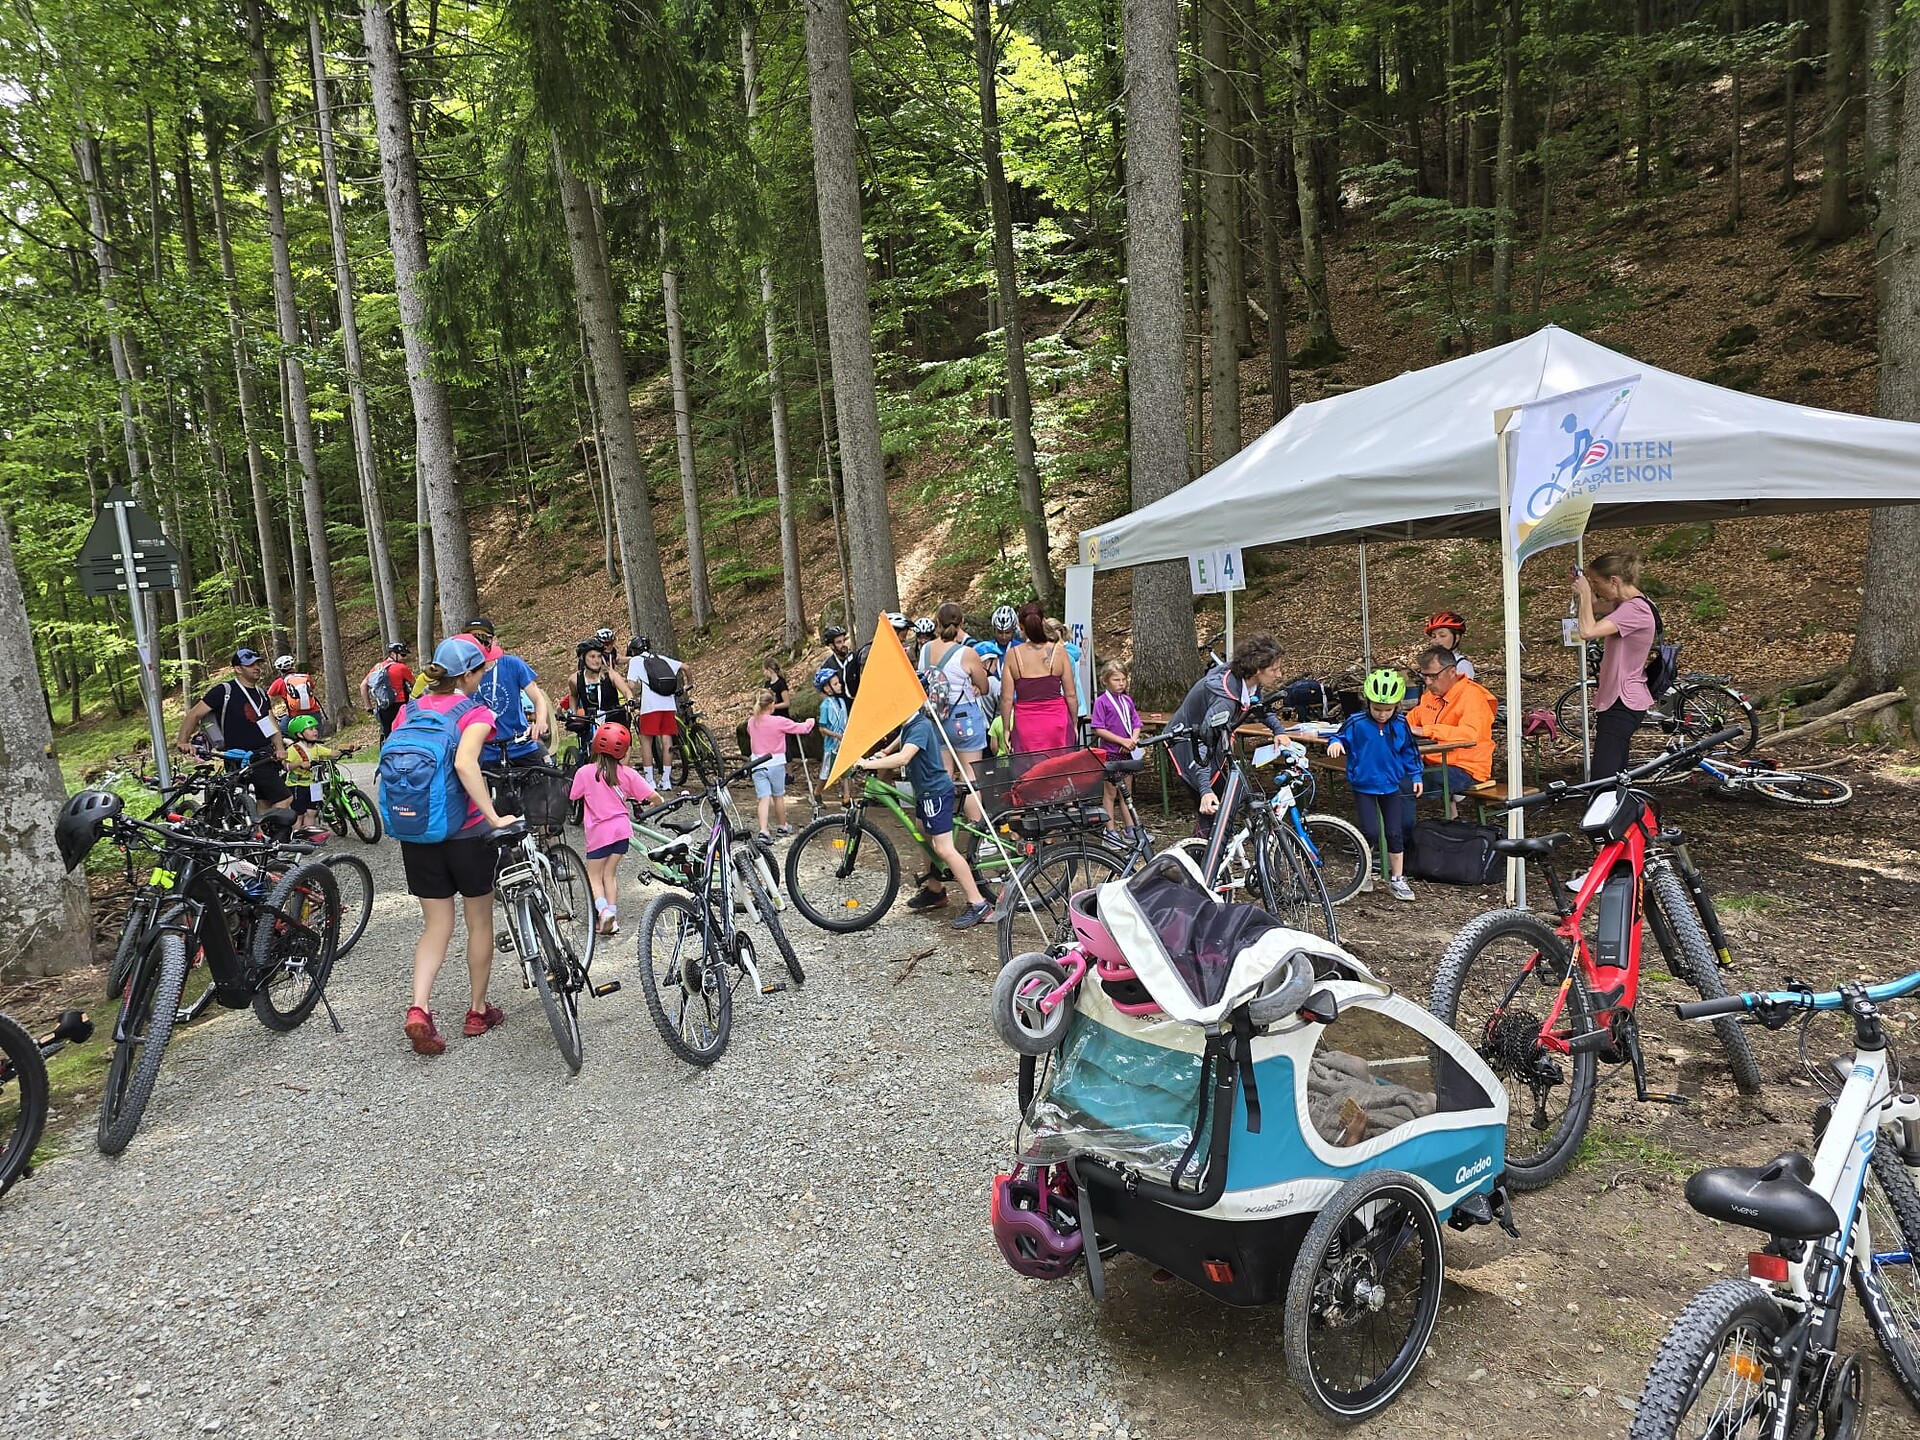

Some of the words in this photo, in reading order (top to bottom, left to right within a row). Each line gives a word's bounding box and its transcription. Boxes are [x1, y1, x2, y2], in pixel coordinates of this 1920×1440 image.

[1608, 440, 1673, 460] ITTEN
[1601, 464, 1673, 484] RENON
[1197, 559, 1207, 584] E
[1224, 553, 1234, 580] 4
[1455, 1155, 1492, 1184] Qeridoo
[1773, 1378, 1792, 1440] BULLS
